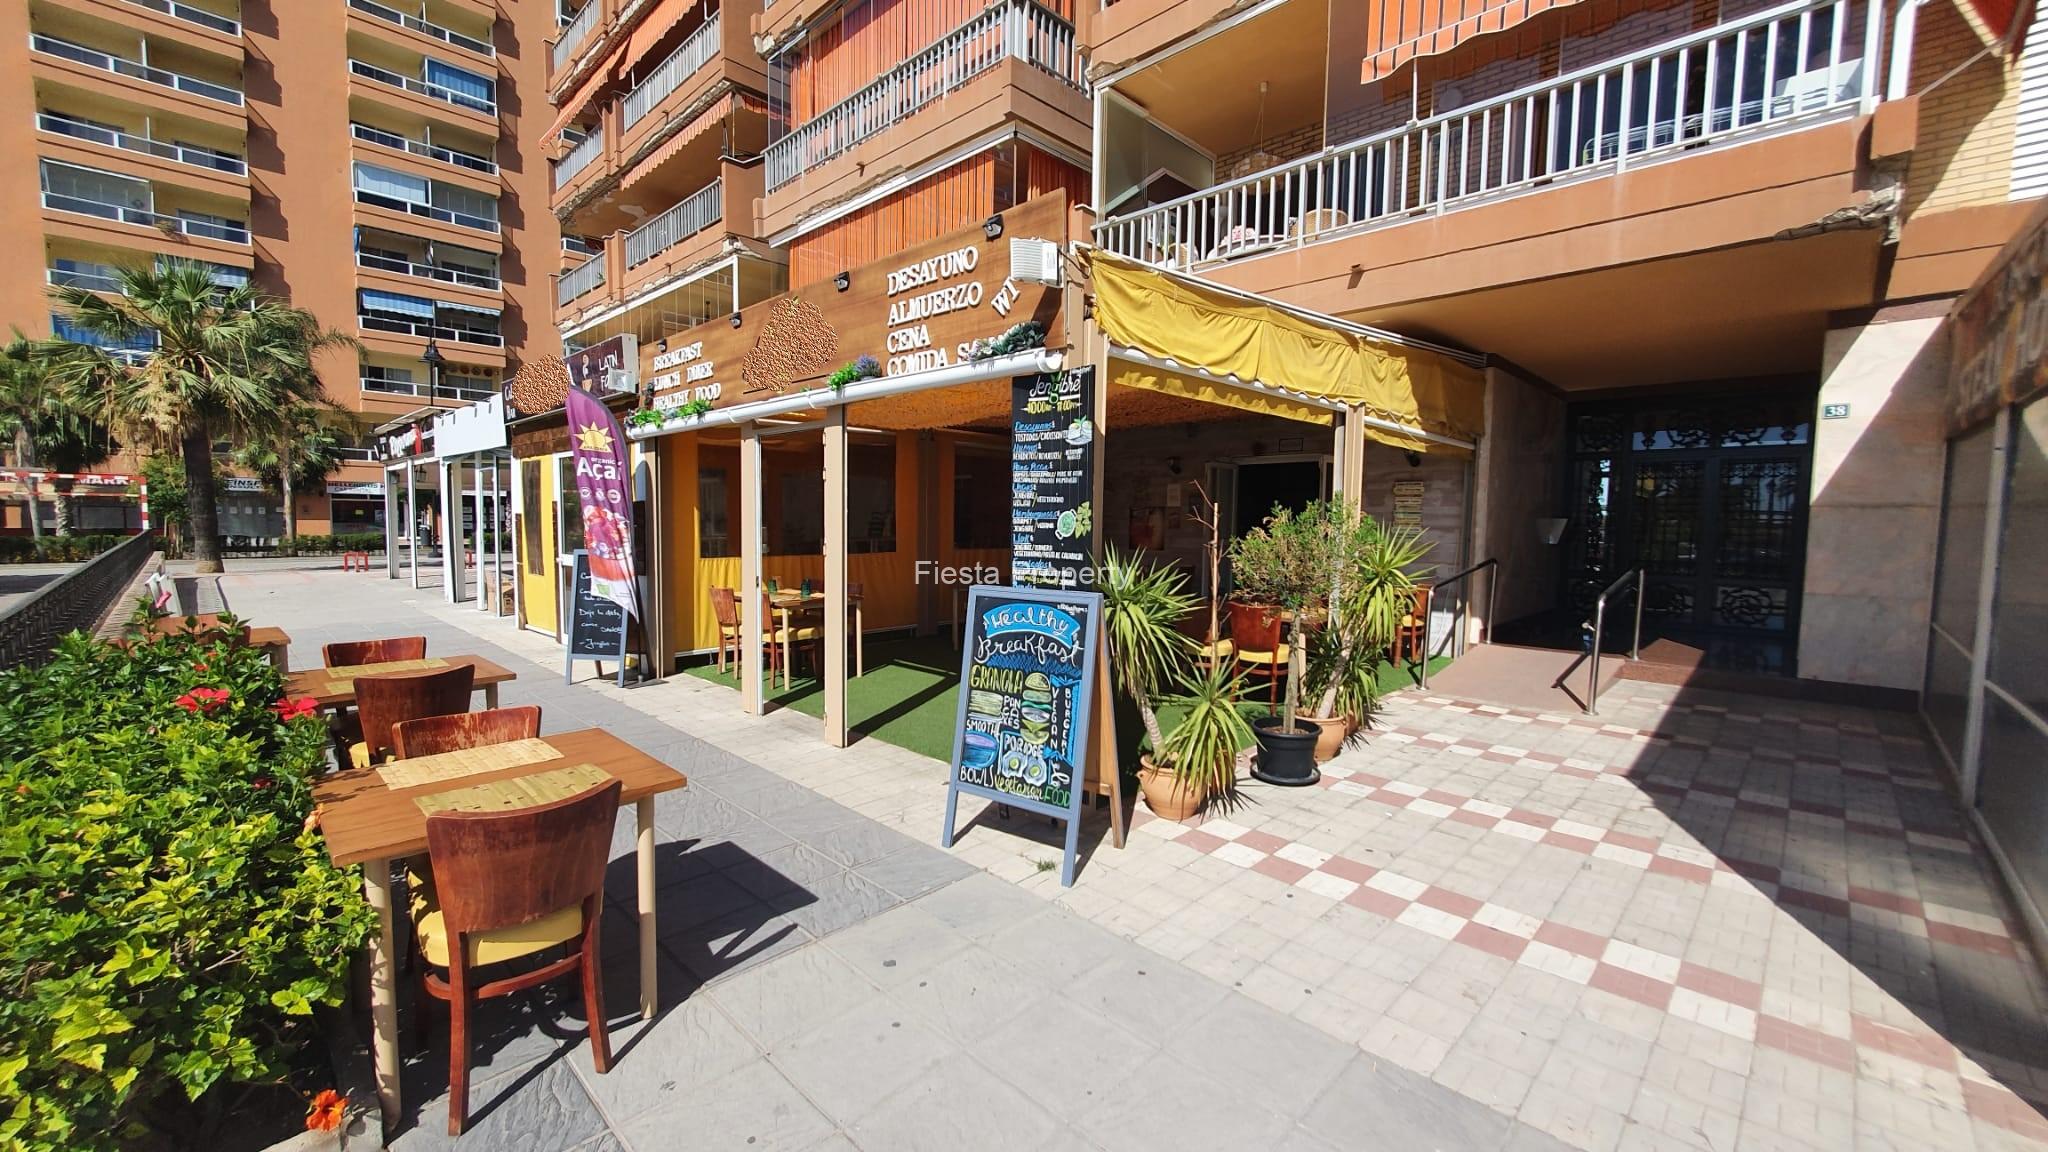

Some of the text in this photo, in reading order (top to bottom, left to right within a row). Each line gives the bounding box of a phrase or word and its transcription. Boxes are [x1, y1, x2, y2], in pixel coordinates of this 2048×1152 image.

[887, 246, 979, 296] DESAYUNO
[887, 281, 983, 327] ALMUERZO
[887, 324, 931, 354] CENA
[653, 342, 703, 372] BREAKFAST
[887, 347, 949, 377] COMIDA
[1826, 405, 1846, 416] 38
[991, 607, 1069, 637] Healthy
[974, 633, 1084, 667] Breakfast
[970, 664, 1024, 694] GRANOLA
[959, 764, 995, 788] BOWLS
[1043, 784, 1072, 807] FOOD
